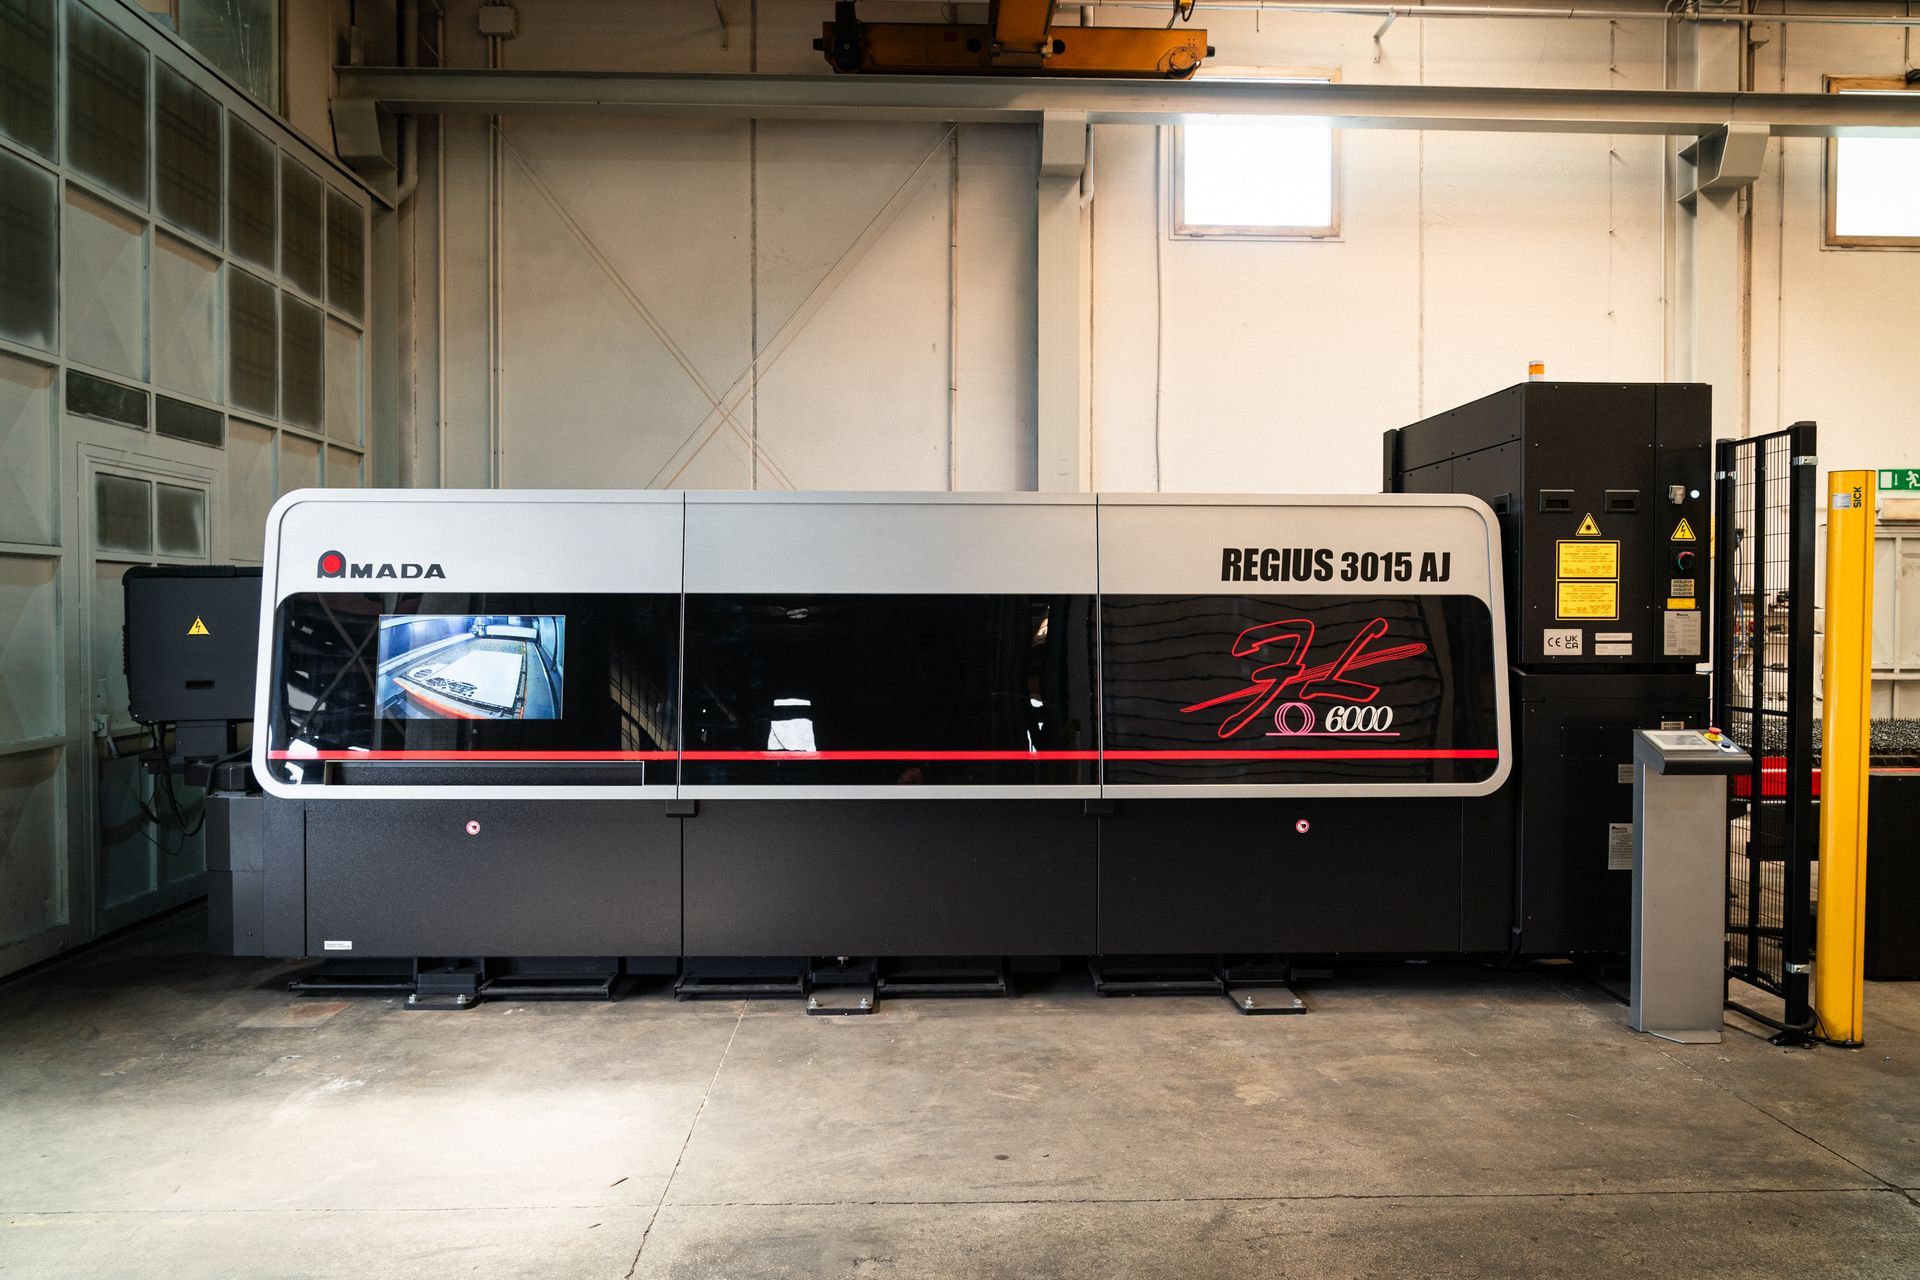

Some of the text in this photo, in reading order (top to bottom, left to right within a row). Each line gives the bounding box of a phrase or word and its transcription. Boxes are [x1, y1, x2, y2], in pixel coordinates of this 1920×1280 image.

[1853, 486, 1862, 508] SICK
[317, 550, 446, 578] AMADA
[1221, 548, 1451, 582] REGIUS 3015 AJ
[1325, 706, 1393, 732] 6000
